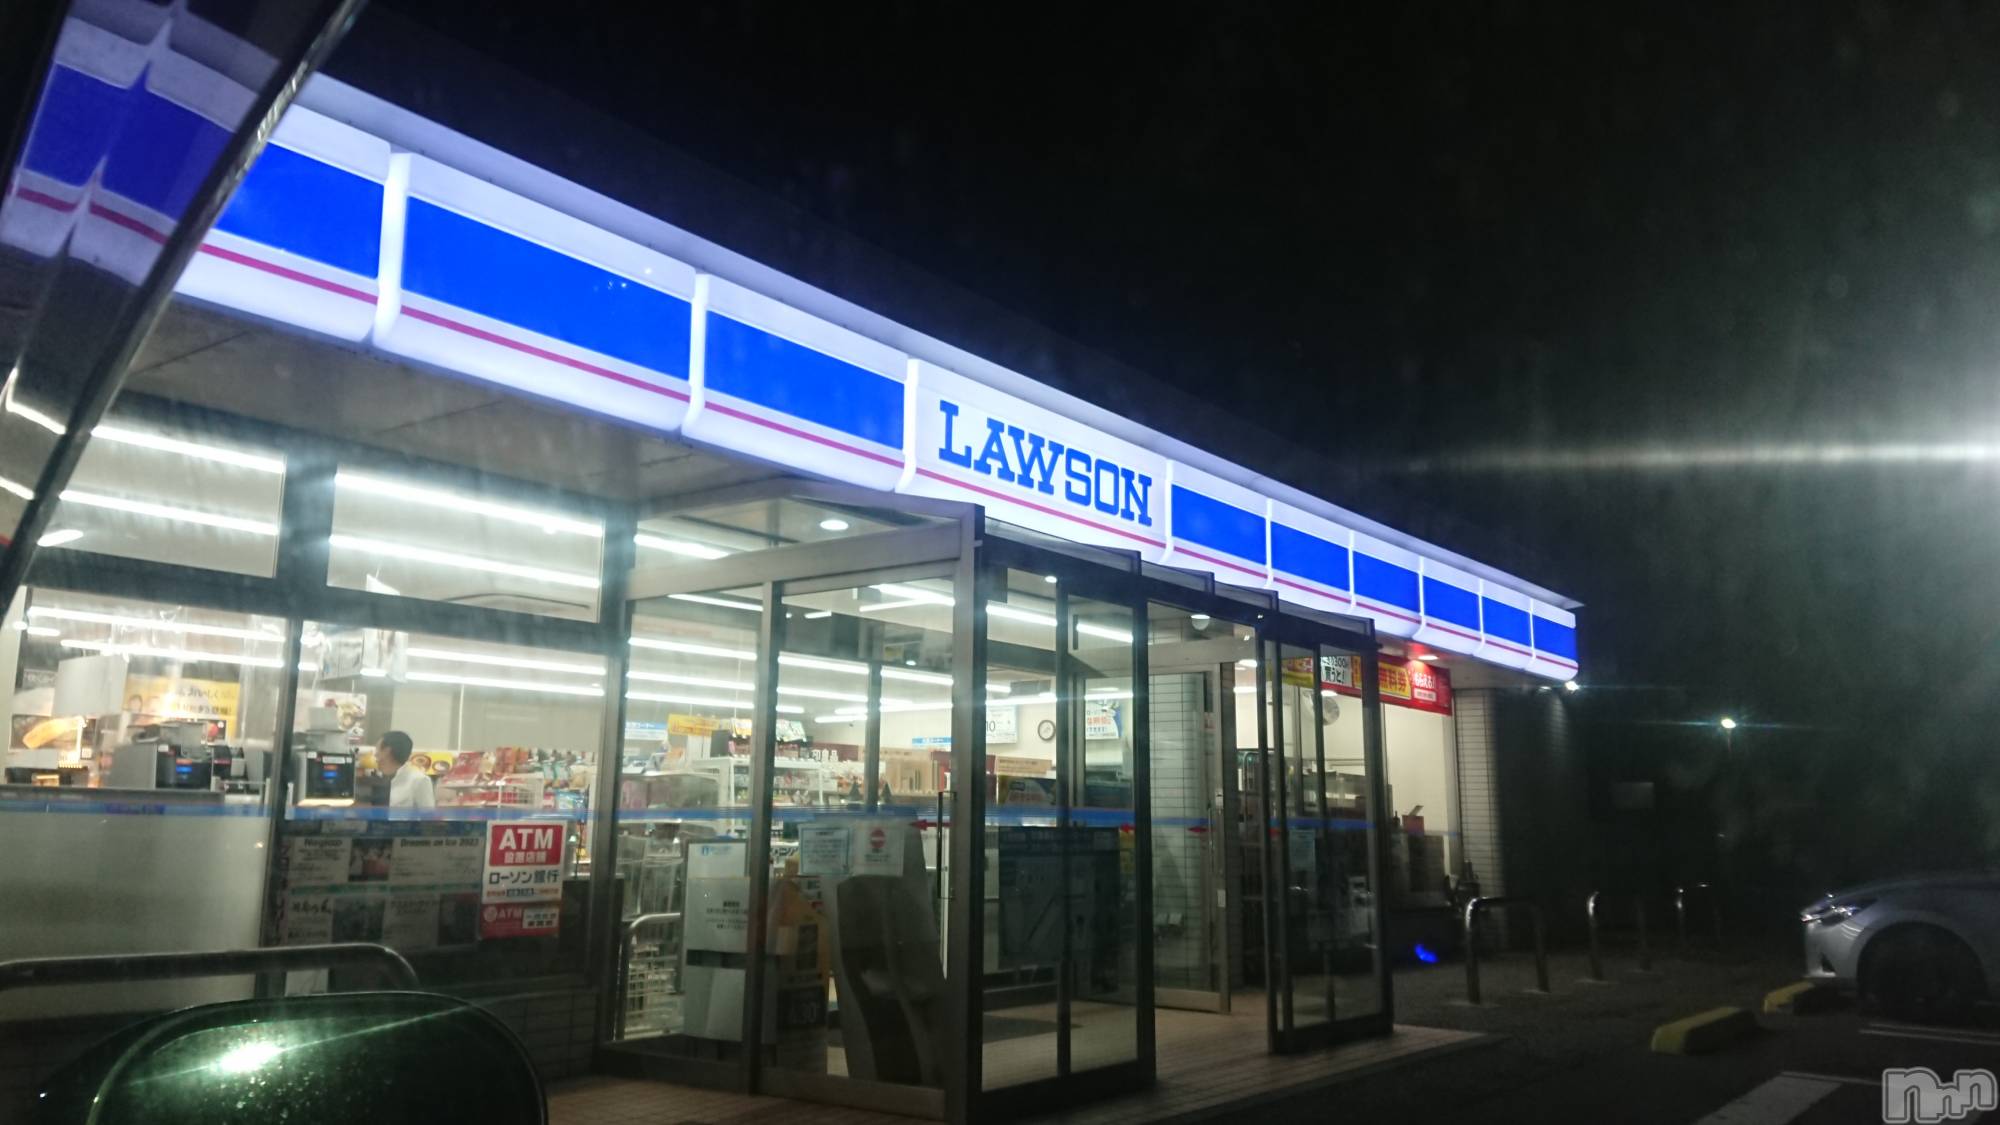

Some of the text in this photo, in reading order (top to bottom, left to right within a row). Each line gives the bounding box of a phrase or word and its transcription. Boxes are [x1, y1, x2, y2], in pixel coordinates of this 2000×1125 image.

[938, 399, 1153, 527] LAWSON
[498, 828, 554, 850] ATM
[497, 907, 523, 919] ATM
